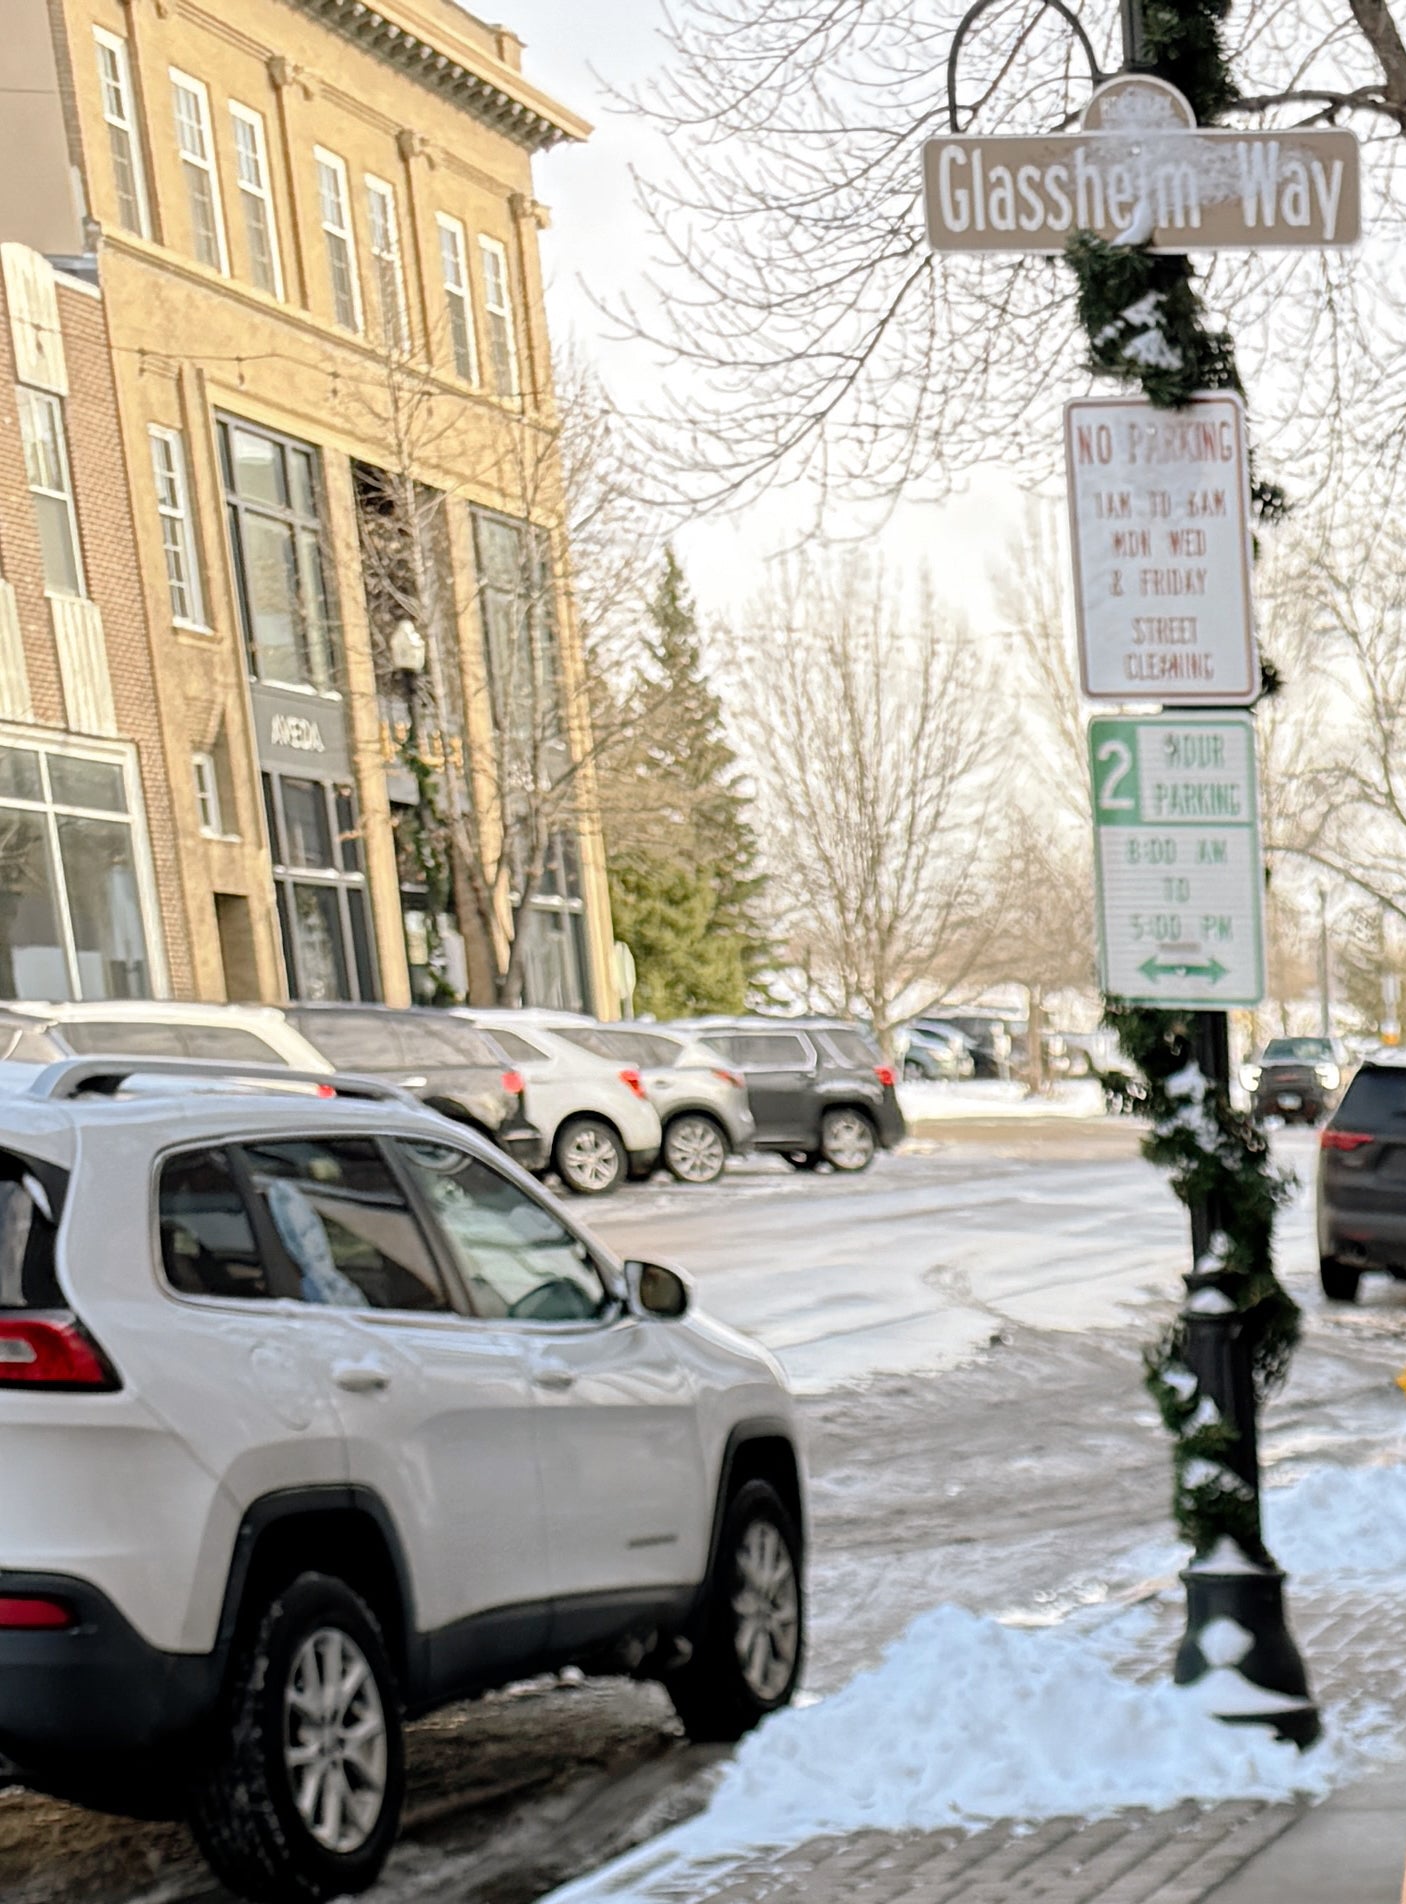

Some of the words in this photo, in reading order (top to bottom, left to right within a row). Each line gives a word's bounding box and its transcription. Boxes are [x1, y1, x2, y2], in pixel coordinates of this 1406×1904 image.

[1236, 140, 1344, 240] Way
[1077, 423, 1113, 465] NO
[1127, 420, 1233, 465] PARKING
[1148, 490, 1172, 518] TO
[1111, 529, 1152, 557] MON
[1169, 529, 1207, 557] WED
[1110, 569, 1125, 596] &
[1140, 568, 1207, 596] FRIDAY
[1131, 616, 1198, 645] STREET
[1123, 653, 1214, 681] CLEANING
[271, 713, 326, 753] AVEDA
[1161, 732, 1224, 768] HOUR
[1099, 740, 1135, 810] 2
[1155, 782, 1240, 817] PARKING
[1195, 839, 1227, 865] AM
[1162, 877, 1190, 902] TO
[1130, 914, 1181, 941] 5:00
[1203, 914, 1234, 941] PM
